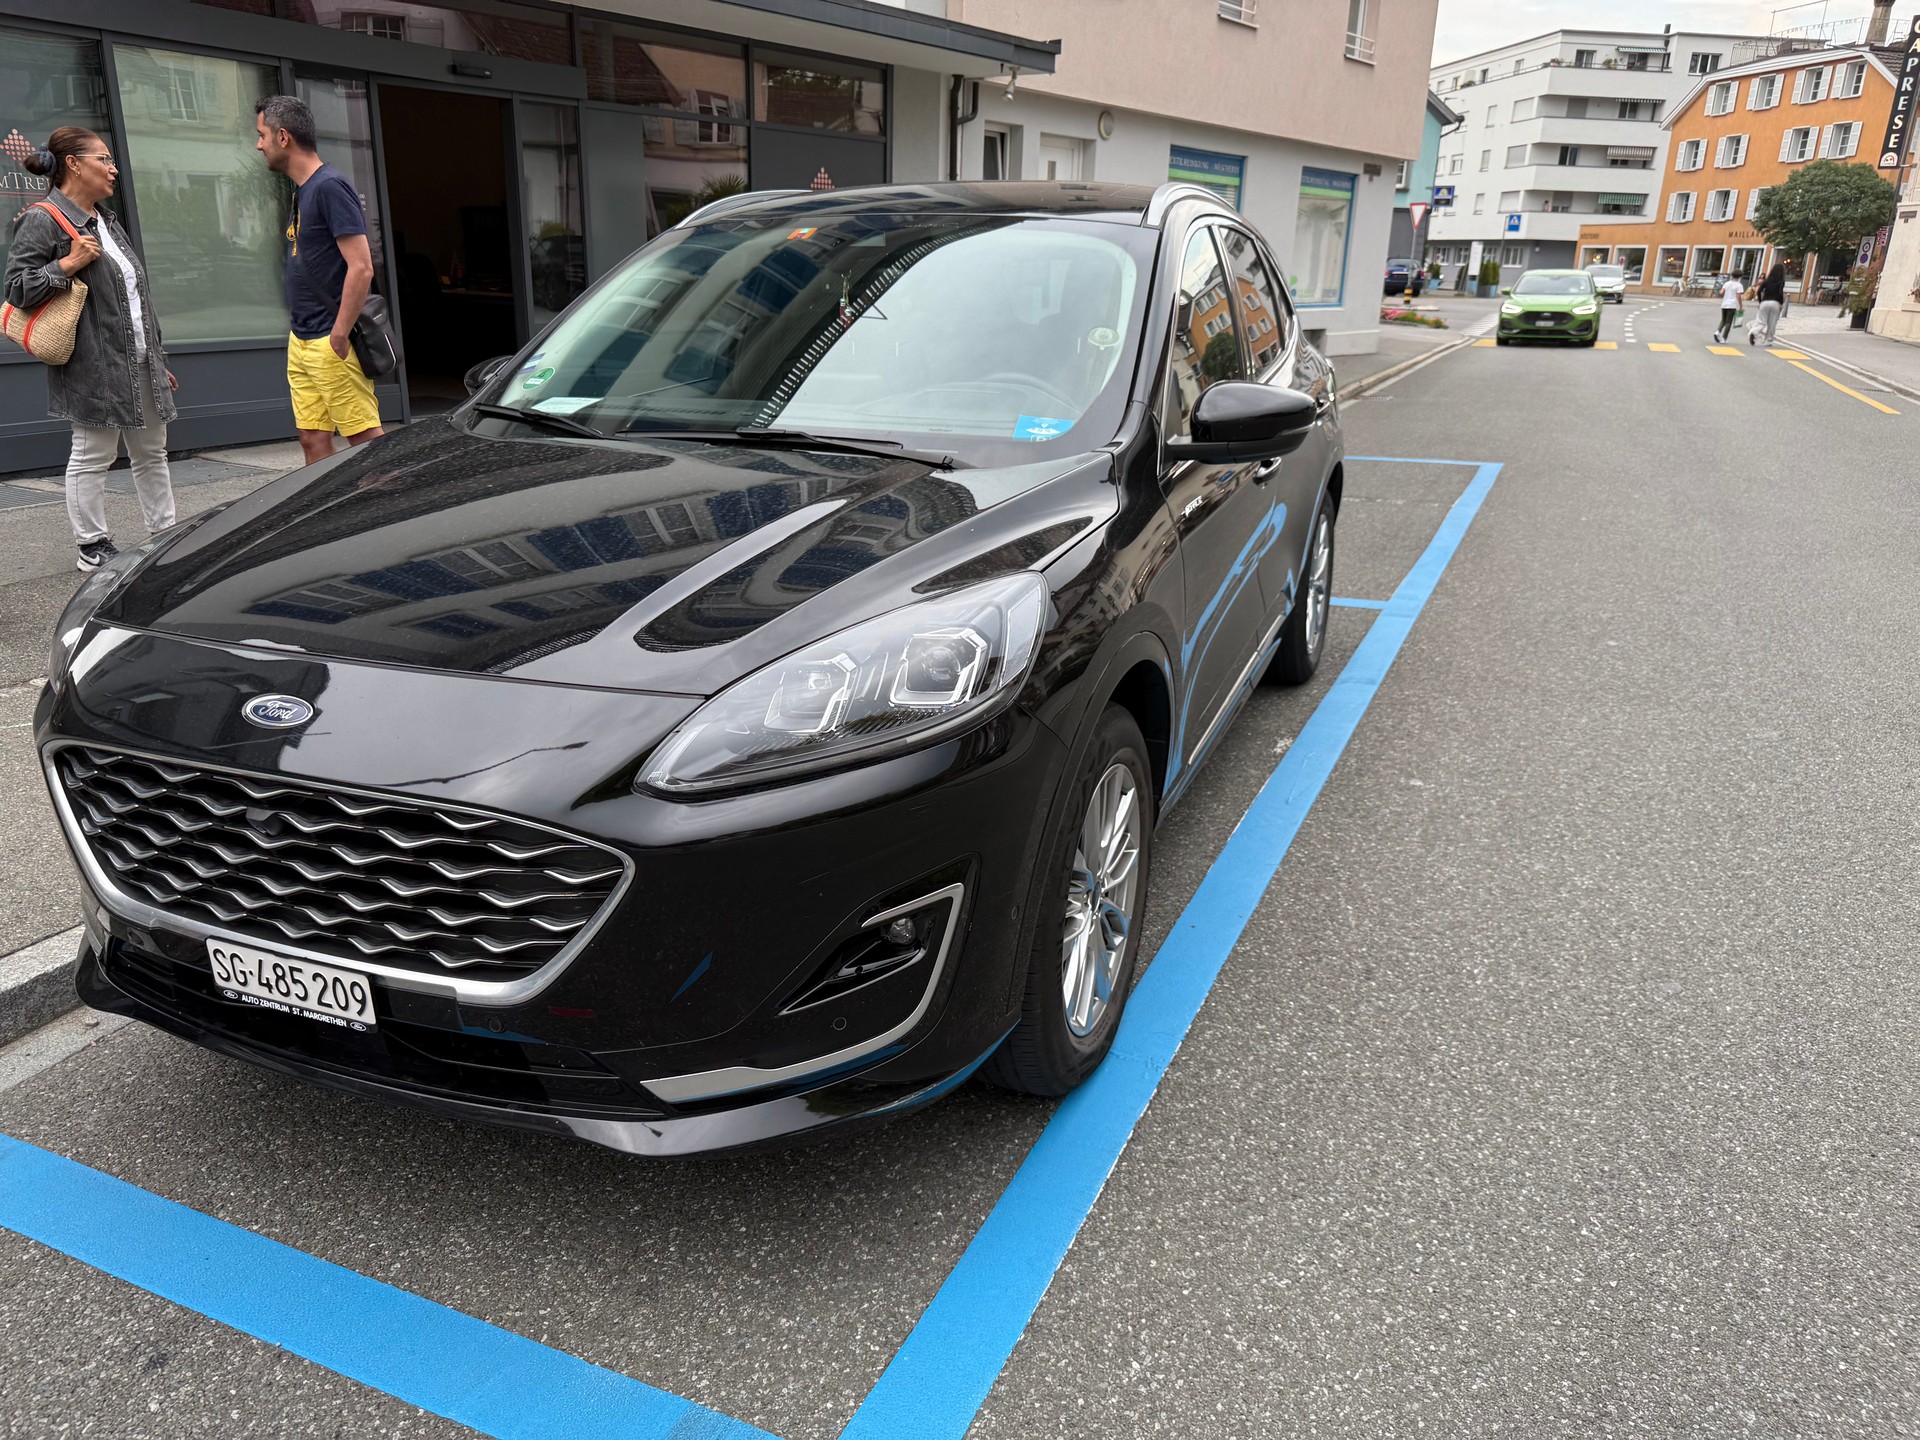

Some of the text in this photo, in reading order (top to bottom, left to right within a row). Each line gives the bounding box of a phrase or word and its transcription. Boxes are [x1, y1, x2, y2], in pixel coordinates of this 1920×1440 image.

[258, 700, 298, 720] Ford
[241, 993, 260, 1006] AUTO
[259, 998, 290, 1014] ZENTRUM
[303, 1009, 347, 1028] MARGRETHEN
